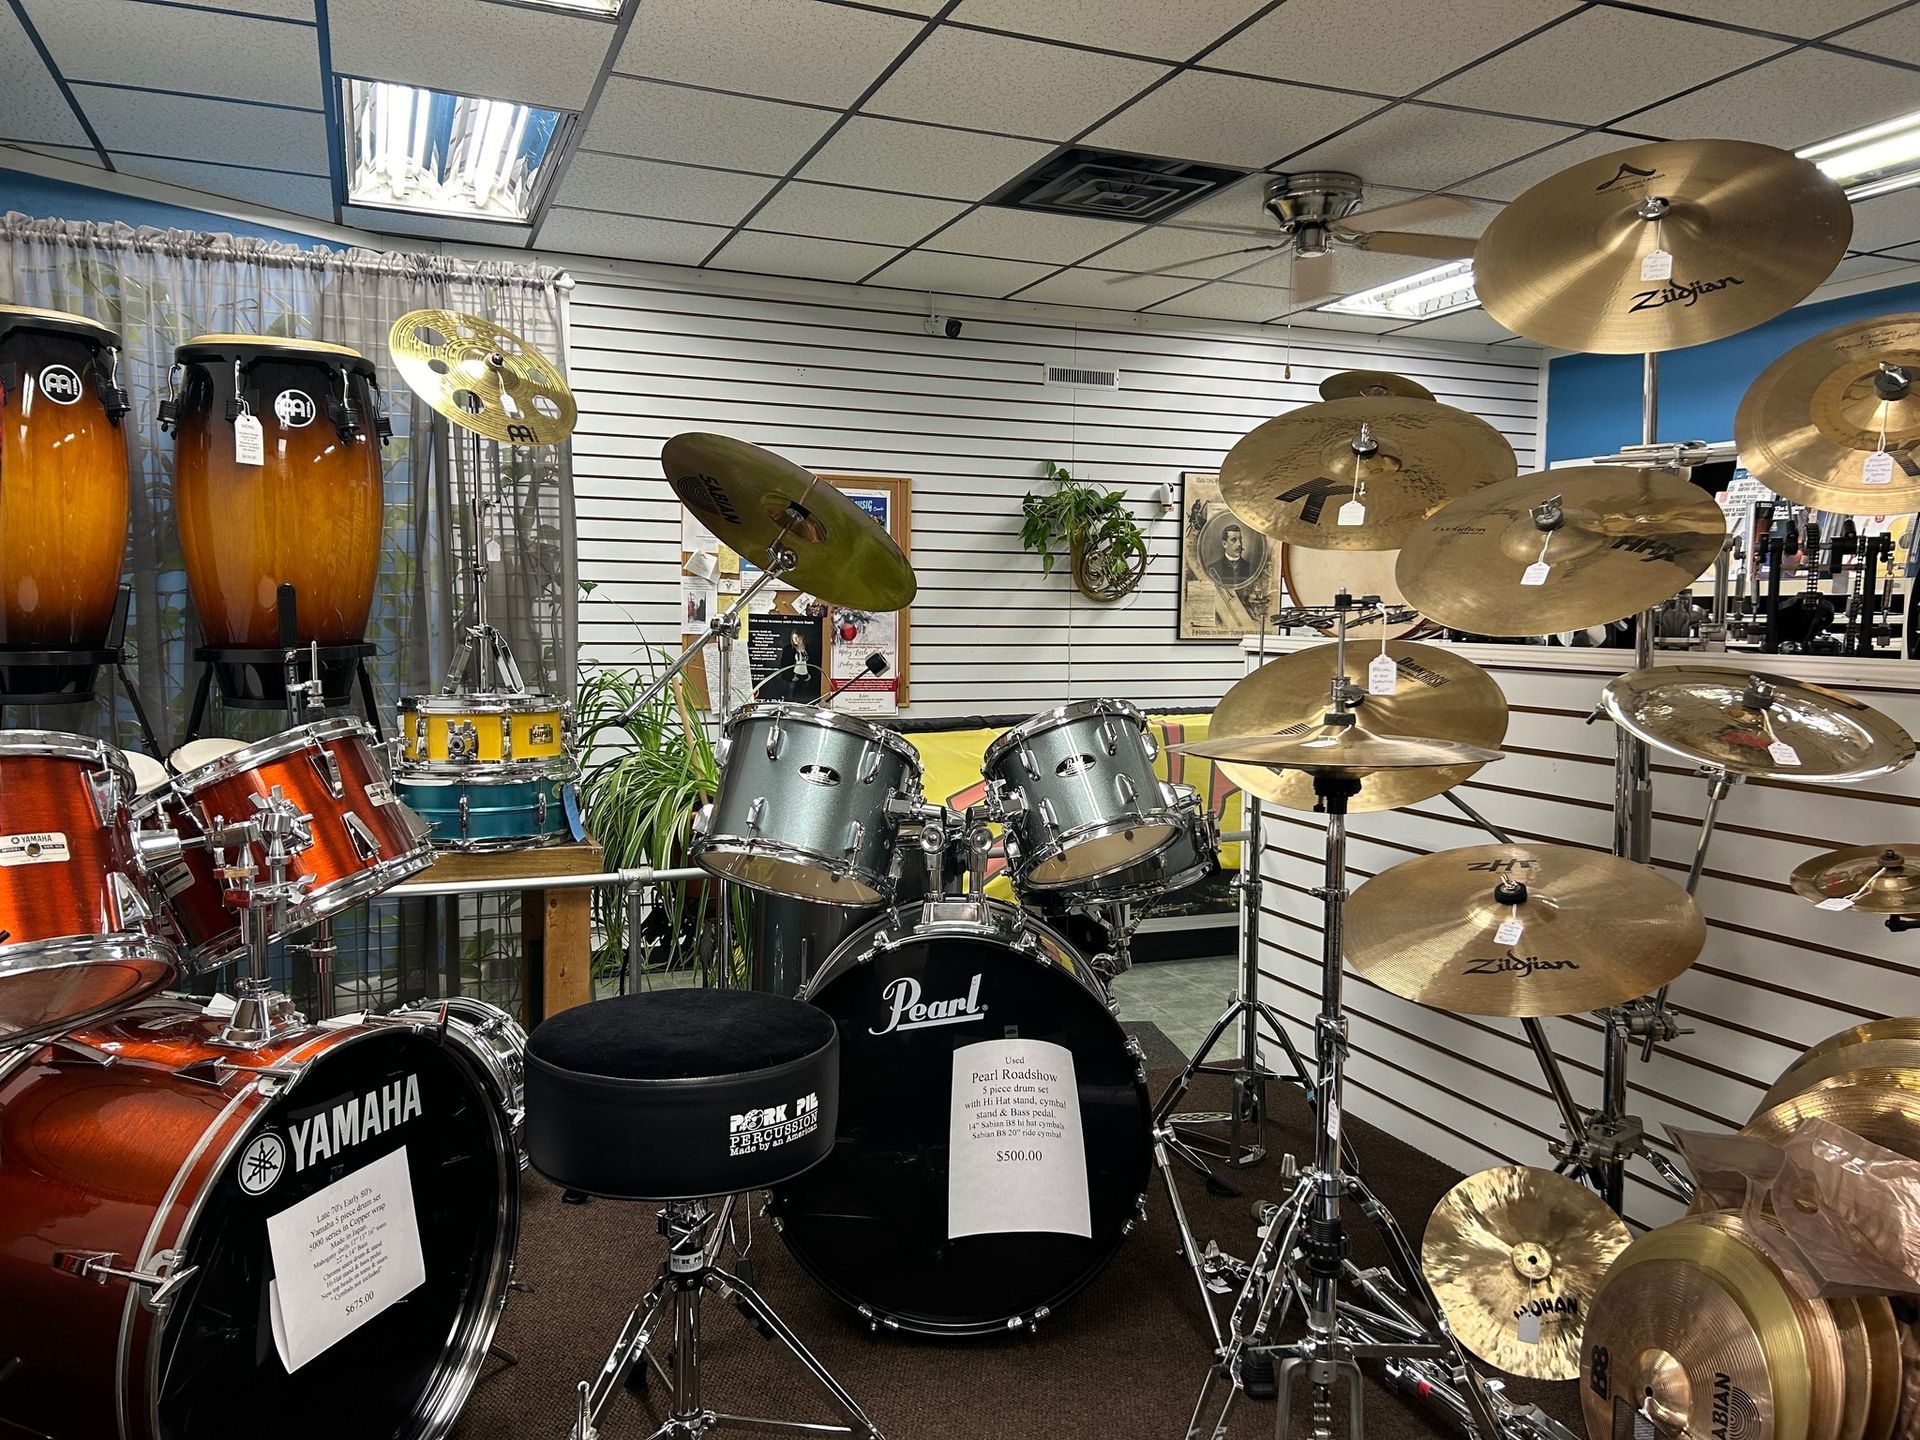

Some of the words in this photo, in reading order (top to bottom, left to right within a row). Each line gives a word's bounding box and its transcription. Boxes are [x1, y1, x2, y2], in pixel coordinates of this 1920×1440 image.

[1628, 278, 1744, 314] Zildjian
[698, 473, 742, 525] SABIAN
[1610, 536, 1687, 562] HHX
[20, 834, 52, 843] YAMAHA
[1462, 949, 1580, 978] Zildjian
[868, 973, 986, 1036] Pearl
[1005, 1056, 1025, 1065] Used
[972, 1069, 998, 1084] Pearl
[1002, 1068, 1058, 1082] Roadshow
[982, 1085, 988, 1095] 5
[989, 1084, 1011, 1095] piece
[1013, 1084, 1036, 1093] drum
[1037, 1085, 1049, 1094] set
[796, 1092, 819, 1117] PIE
[964, 1098, 981, 1109] with
[983, 1097, 994, 1106] Hi
[995, 1096, 1010, 1105] Hat
[1012, 1096, 1038, 1106] stand,
[1039, 1098, 1067, 1110] cymbal
[976, 1108, 998, 1119] stand
[999, 1108, 1008, 1117] &
[1010, 1107, 1030, 1117] Bass
[288, 1073, 422, 1173] YAMAHA
[729, 1111, 818, 1148] PERCUSSION
[972, 1130, 995, 1140] Sabian
[1022, 1129, 1036, 1137] ride
[1037, 1130, 1062, 1140] cymbal
[981, 1119, 1004, 1129] Sabian
[1026, 1119, 1037, 1127] hat
[730, 1145, 757, 1157] Made
[759, 1142, 771, 1152] by
[772, 1138, 784, 1147] an
[785, 1123, 818, 1143] American
[996, 1150, 1043, 1162] $500.00
[310, 1220, 335, 1238] Yamaha
[340, 1208, 356, 1223] piece
[356, 1199, 372, 1212] drum
[372, 1193, 382, 1204] set
[316, 1210, 330, 1223] Late
[330, 1203, 343, 1215] 70's
[343, 1194, 359, 1209] Early
[360, 1187, 373, 1199] 80's
[308, 1237, 324, 1252] 5000
[325, 1228, 342, 1242] series
[342, 1222, 349, 1232] in
[349, 1211, 371, 1228] Copper
[371, 1202, 386, 1215] wrap
[330, 1237, 345, 1250] Made
[313, 1253, 337, 1270] Mahogany
[345, 1290, 374, 1316] $675.00
[1591, 1344, 1609, 1401] B8
[1711, 1372, 1731, 1440] ABIAN
